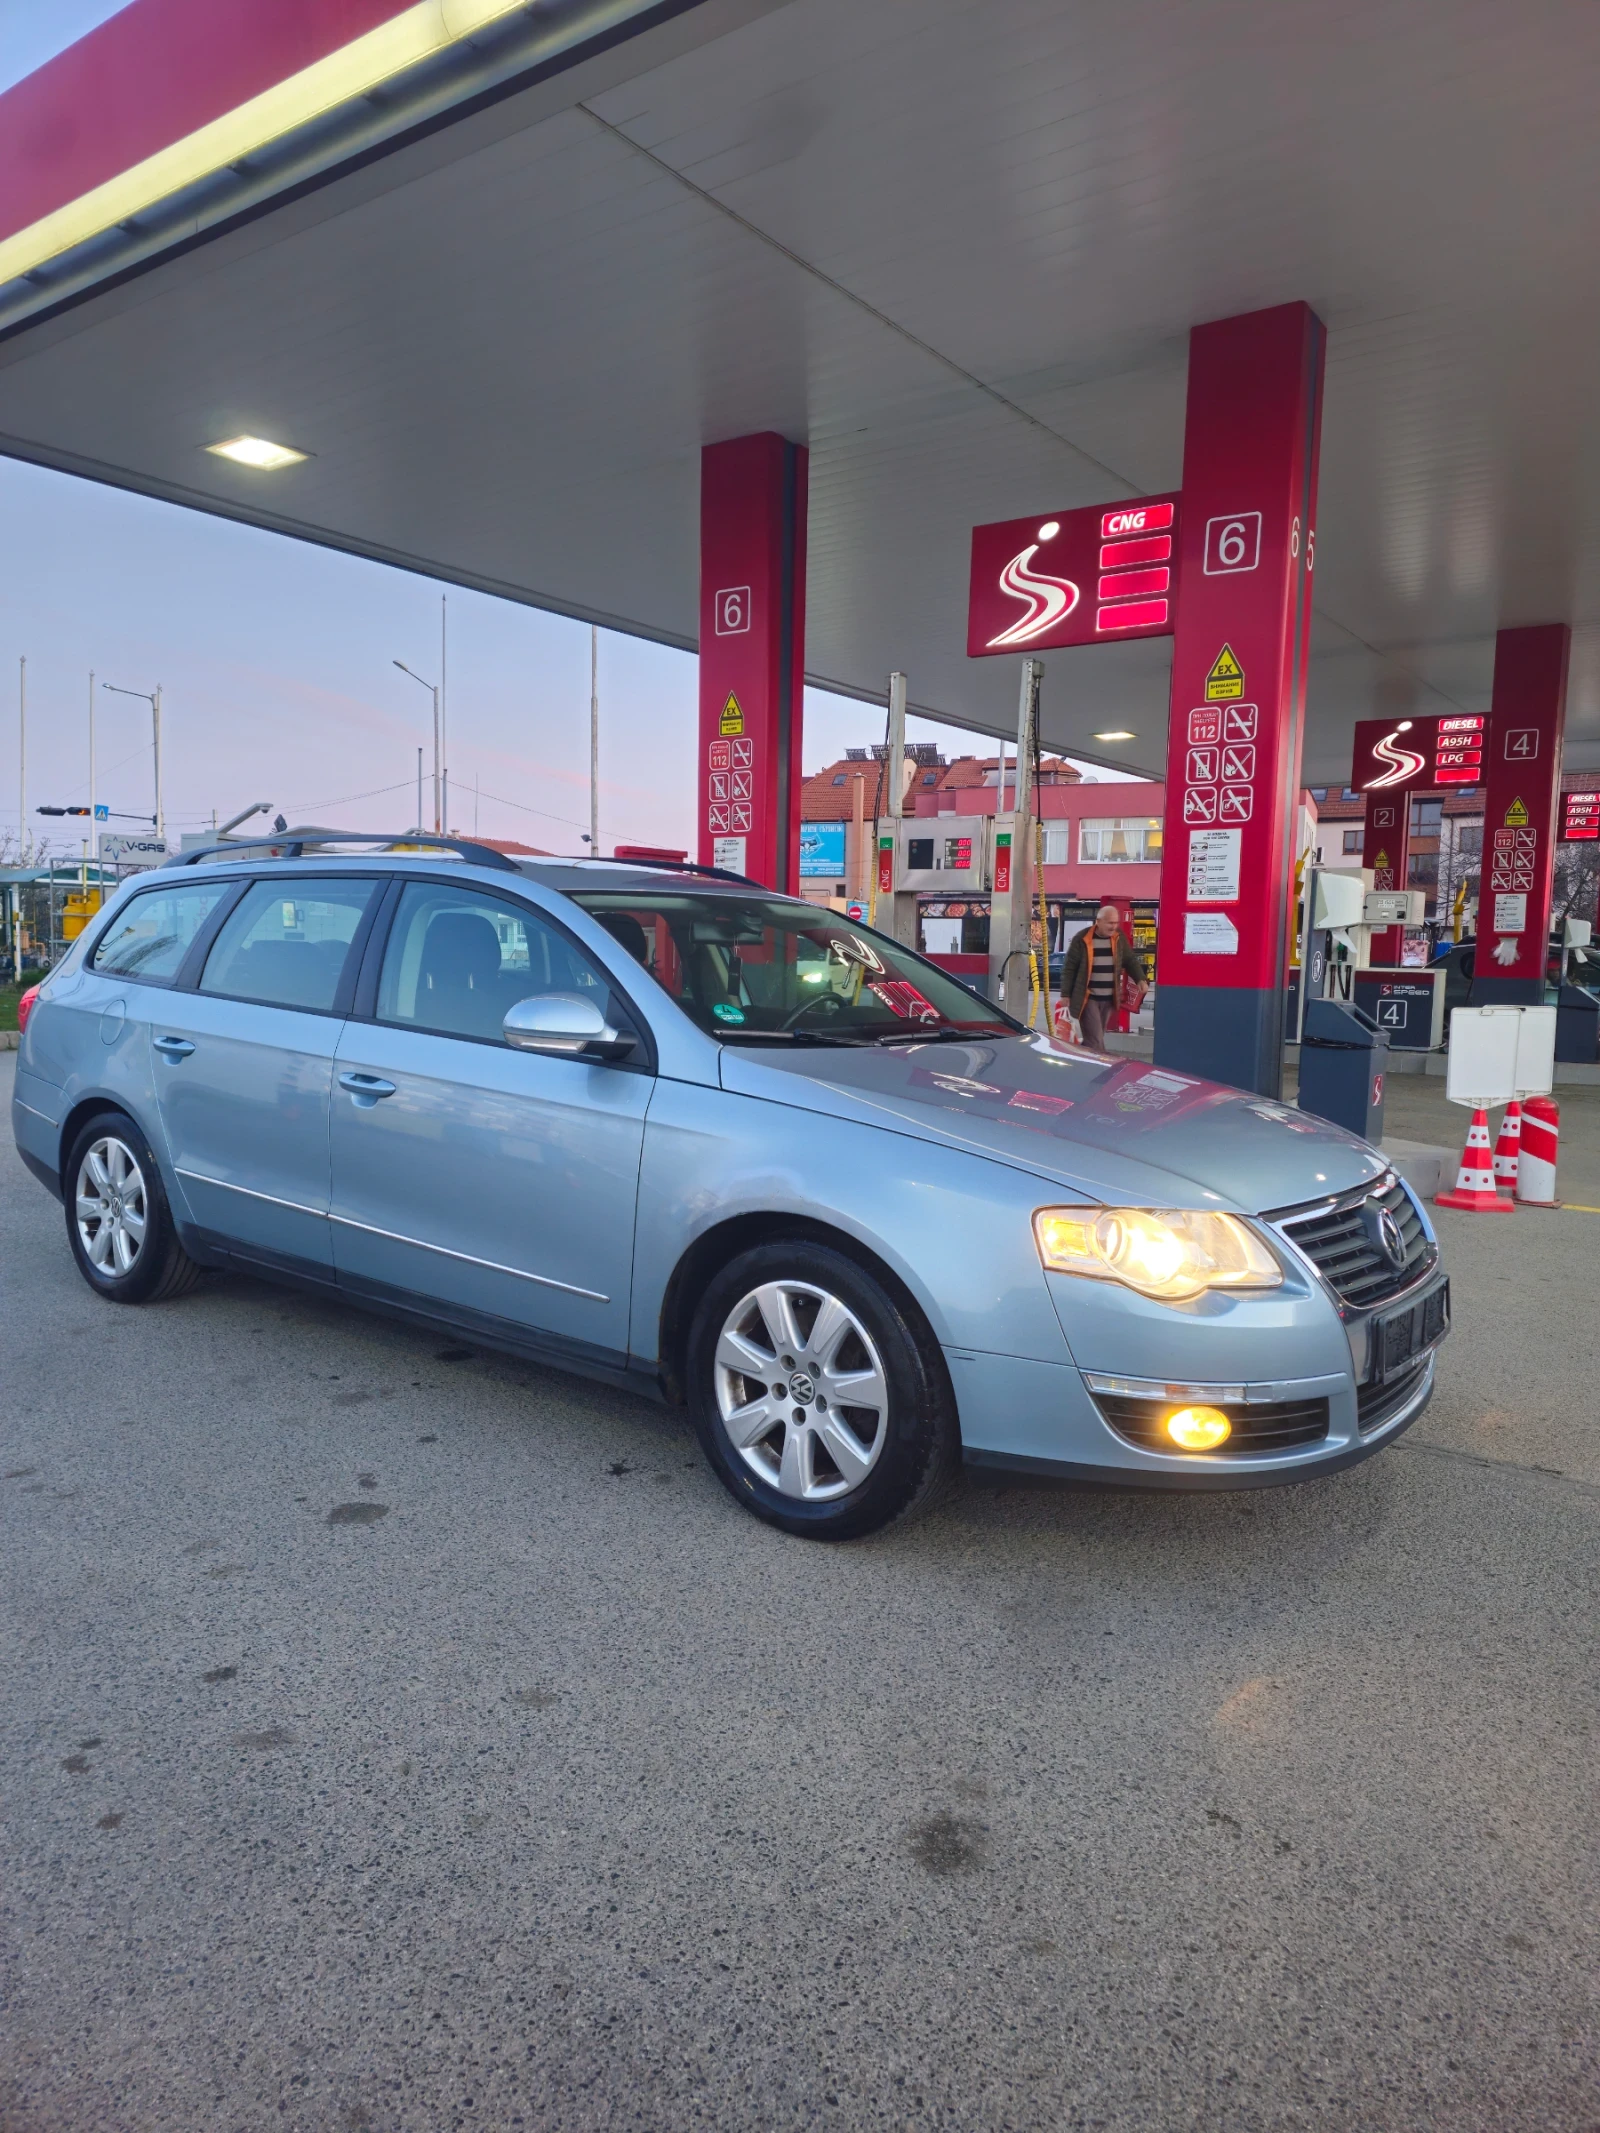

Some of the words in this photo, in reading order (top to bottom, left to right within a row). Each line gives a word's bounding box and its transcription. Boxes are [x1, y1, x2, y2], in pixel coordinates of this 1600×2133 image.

[1108, 511, 1147, 533] CNG
[1218, 522, 1246, 565] 6
[1291, 516, 1300, 558] 6
[1306, 529, 1315, 571] 5
[724, 594, 741, 628] 6
[1217, 664, 1233, 675] EX
[726, 707, 736, 716] EX
[1193, 725, 1216, 739] 112
[1442, 719, 1479, 730] DIESEL
[1441, 736, 1472, 747] A95H
[1512, 733, 1530, 756] 4
[713, 755, 727, 766] 112
[1441, 753, 1464, 764] LPG
[1379, 810, 1389, 825] 2
[1570, 806, 1593, 814] A95H
[881, 869, 890, 889] CNG
[997, 867, 1007, 888] CNG
[1383, 1004, 1400, 1025] 4
